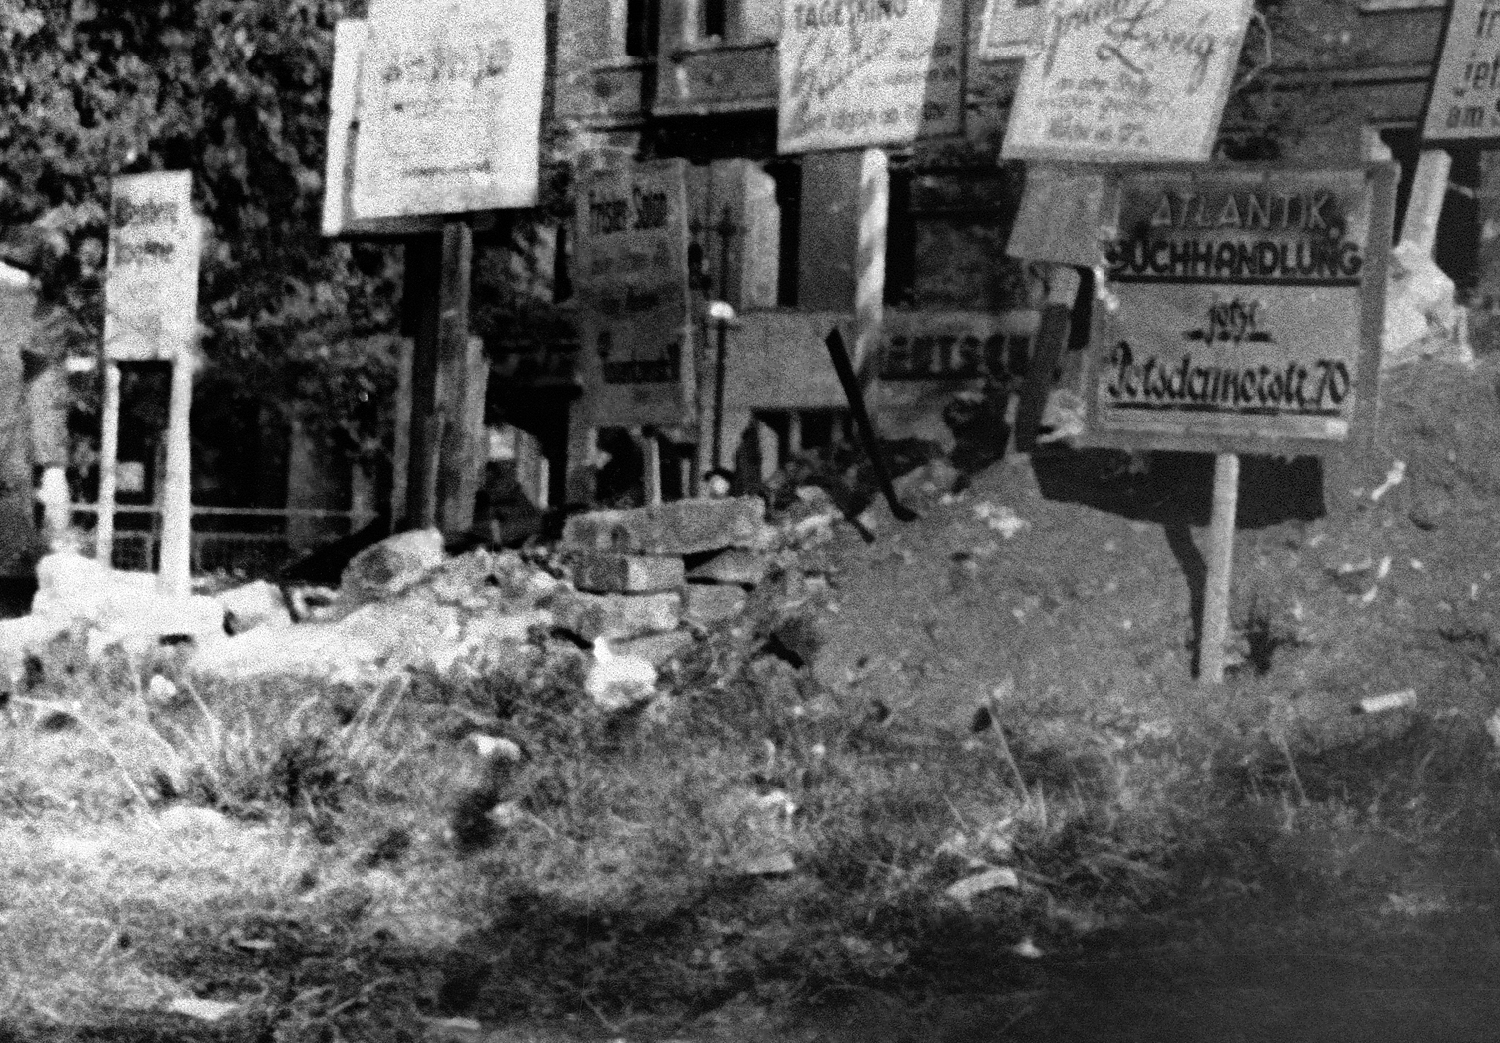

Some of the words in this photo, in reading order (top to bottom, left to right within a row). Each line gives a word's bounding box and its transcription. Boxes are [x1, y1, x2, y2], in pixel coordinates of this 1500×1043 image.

[1446, 101, 1484, 129] am
[1150, 193, 1331, 230] ATLANTIK
[1105, 238, 1364, 276] BUCHHANDLUNG
